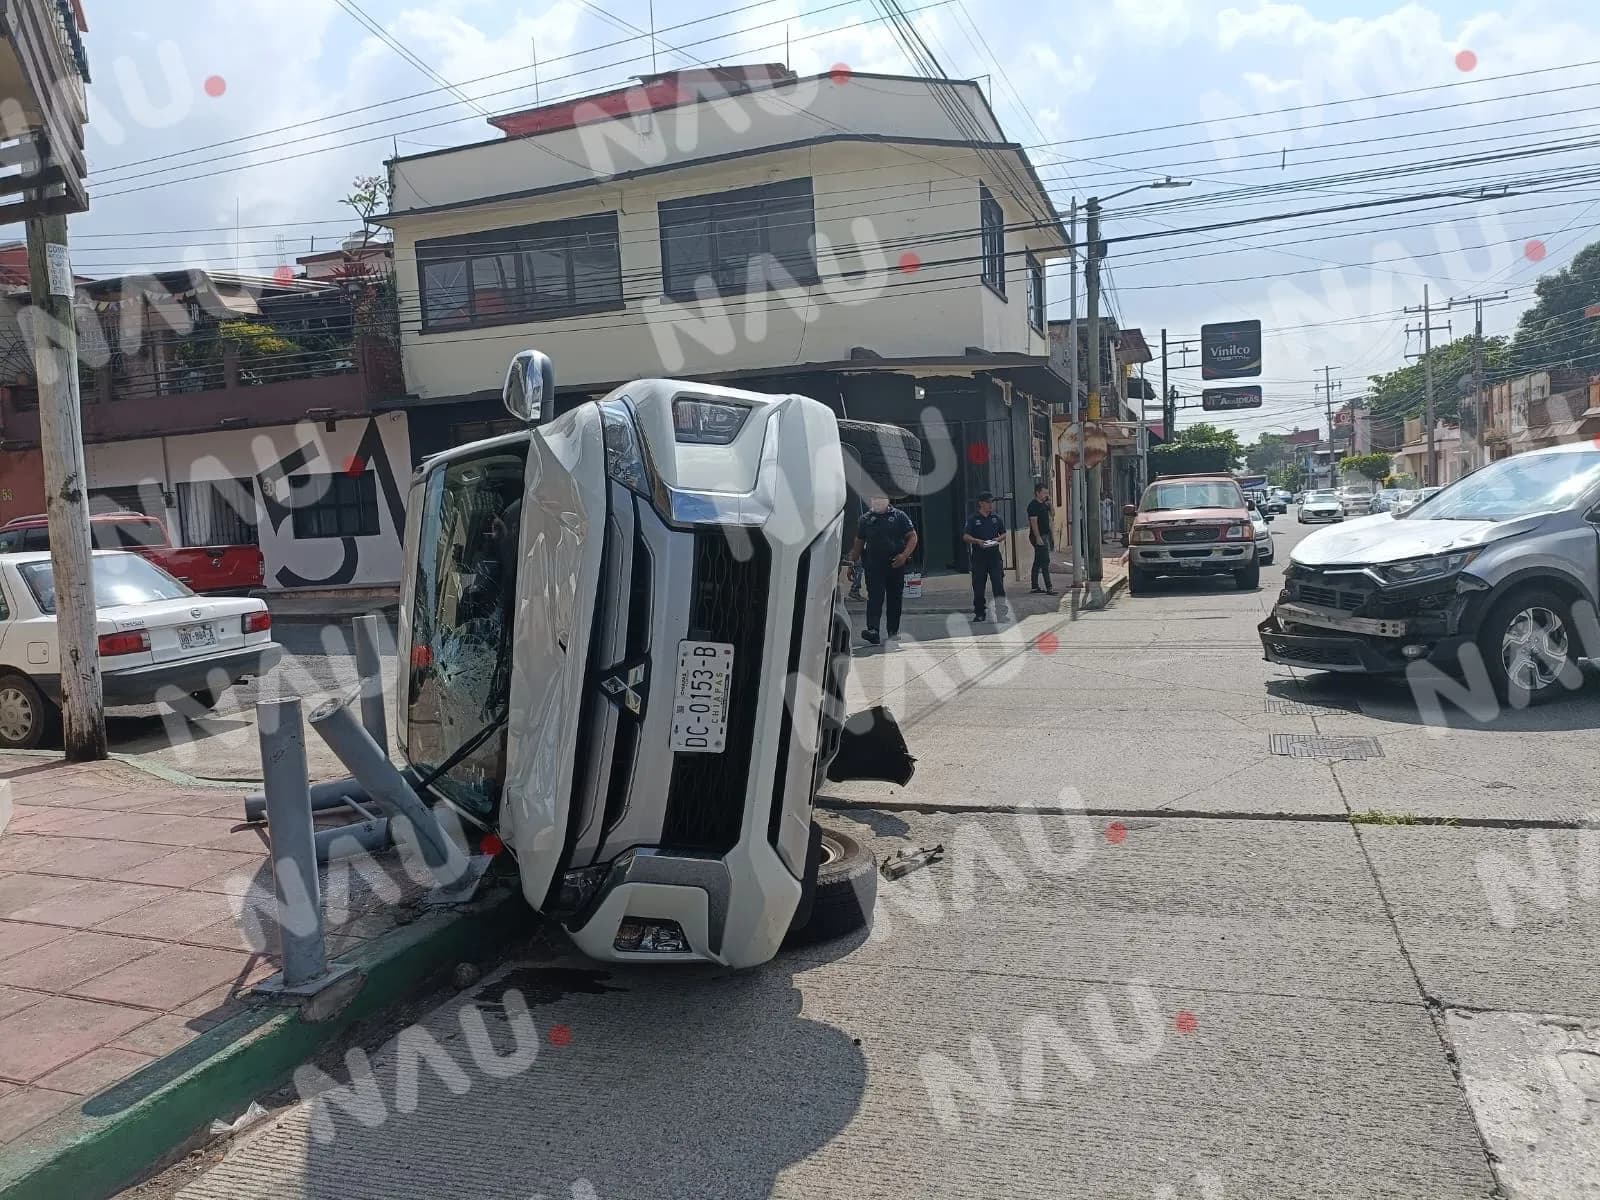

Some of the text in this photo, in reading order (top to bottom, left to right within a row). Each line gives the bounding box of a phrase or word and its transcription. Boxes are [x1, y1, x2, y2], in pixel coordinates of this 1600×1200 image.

[1210, 345, 1250, 357] Vinilco
[685, 646, 717, 748] DC-0153-B
[711, 672, 723, 723] CHIAPAS
